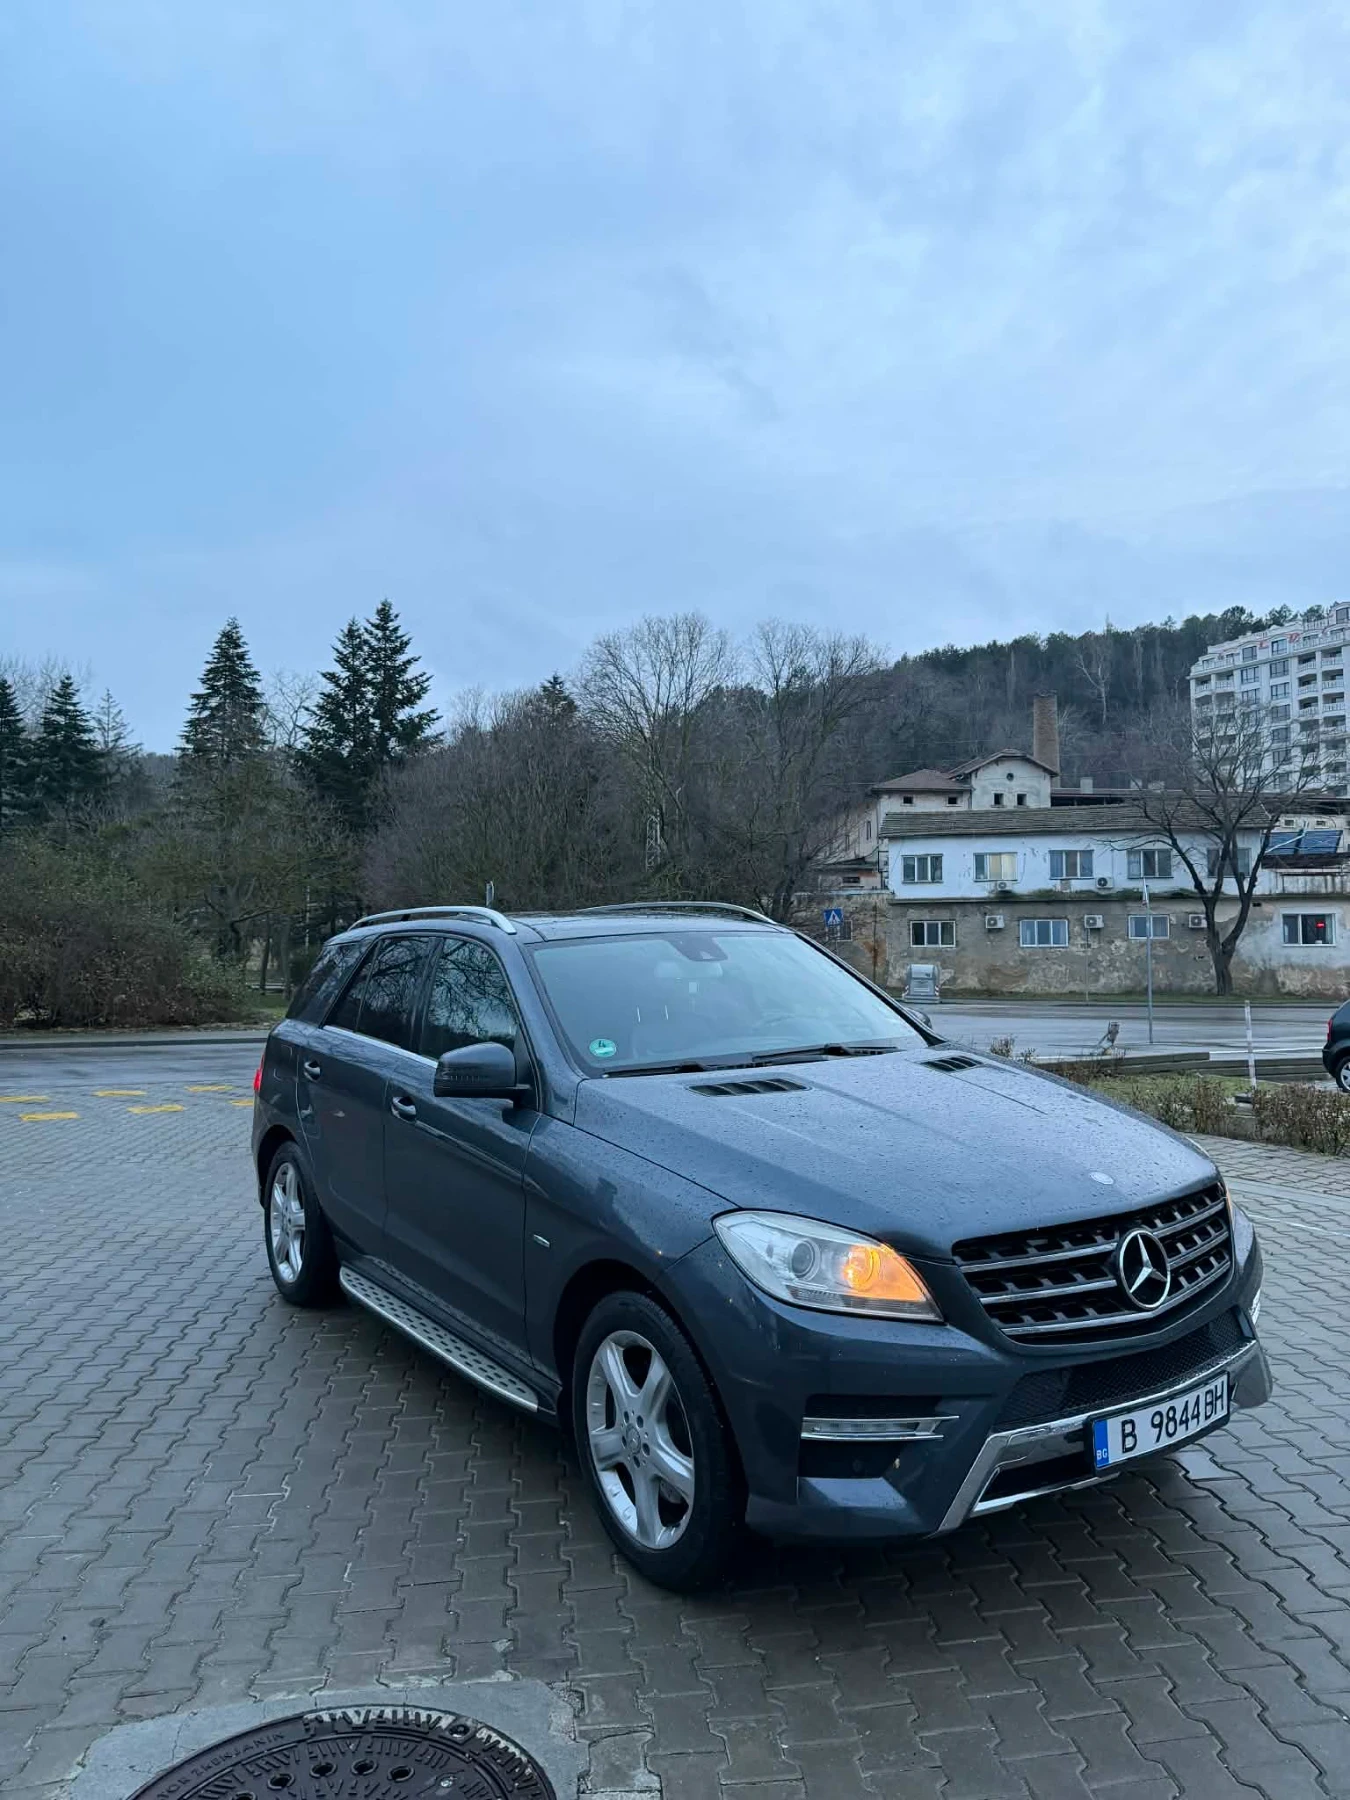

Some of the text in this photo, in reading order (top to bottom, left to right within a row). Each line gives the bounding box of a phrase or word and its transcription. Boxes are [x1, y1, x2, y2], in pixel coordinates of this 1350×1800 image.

[1121, 1380, 1225, 1453] B 9844 BH
[1096, 1448, 1108, 1460] BG
